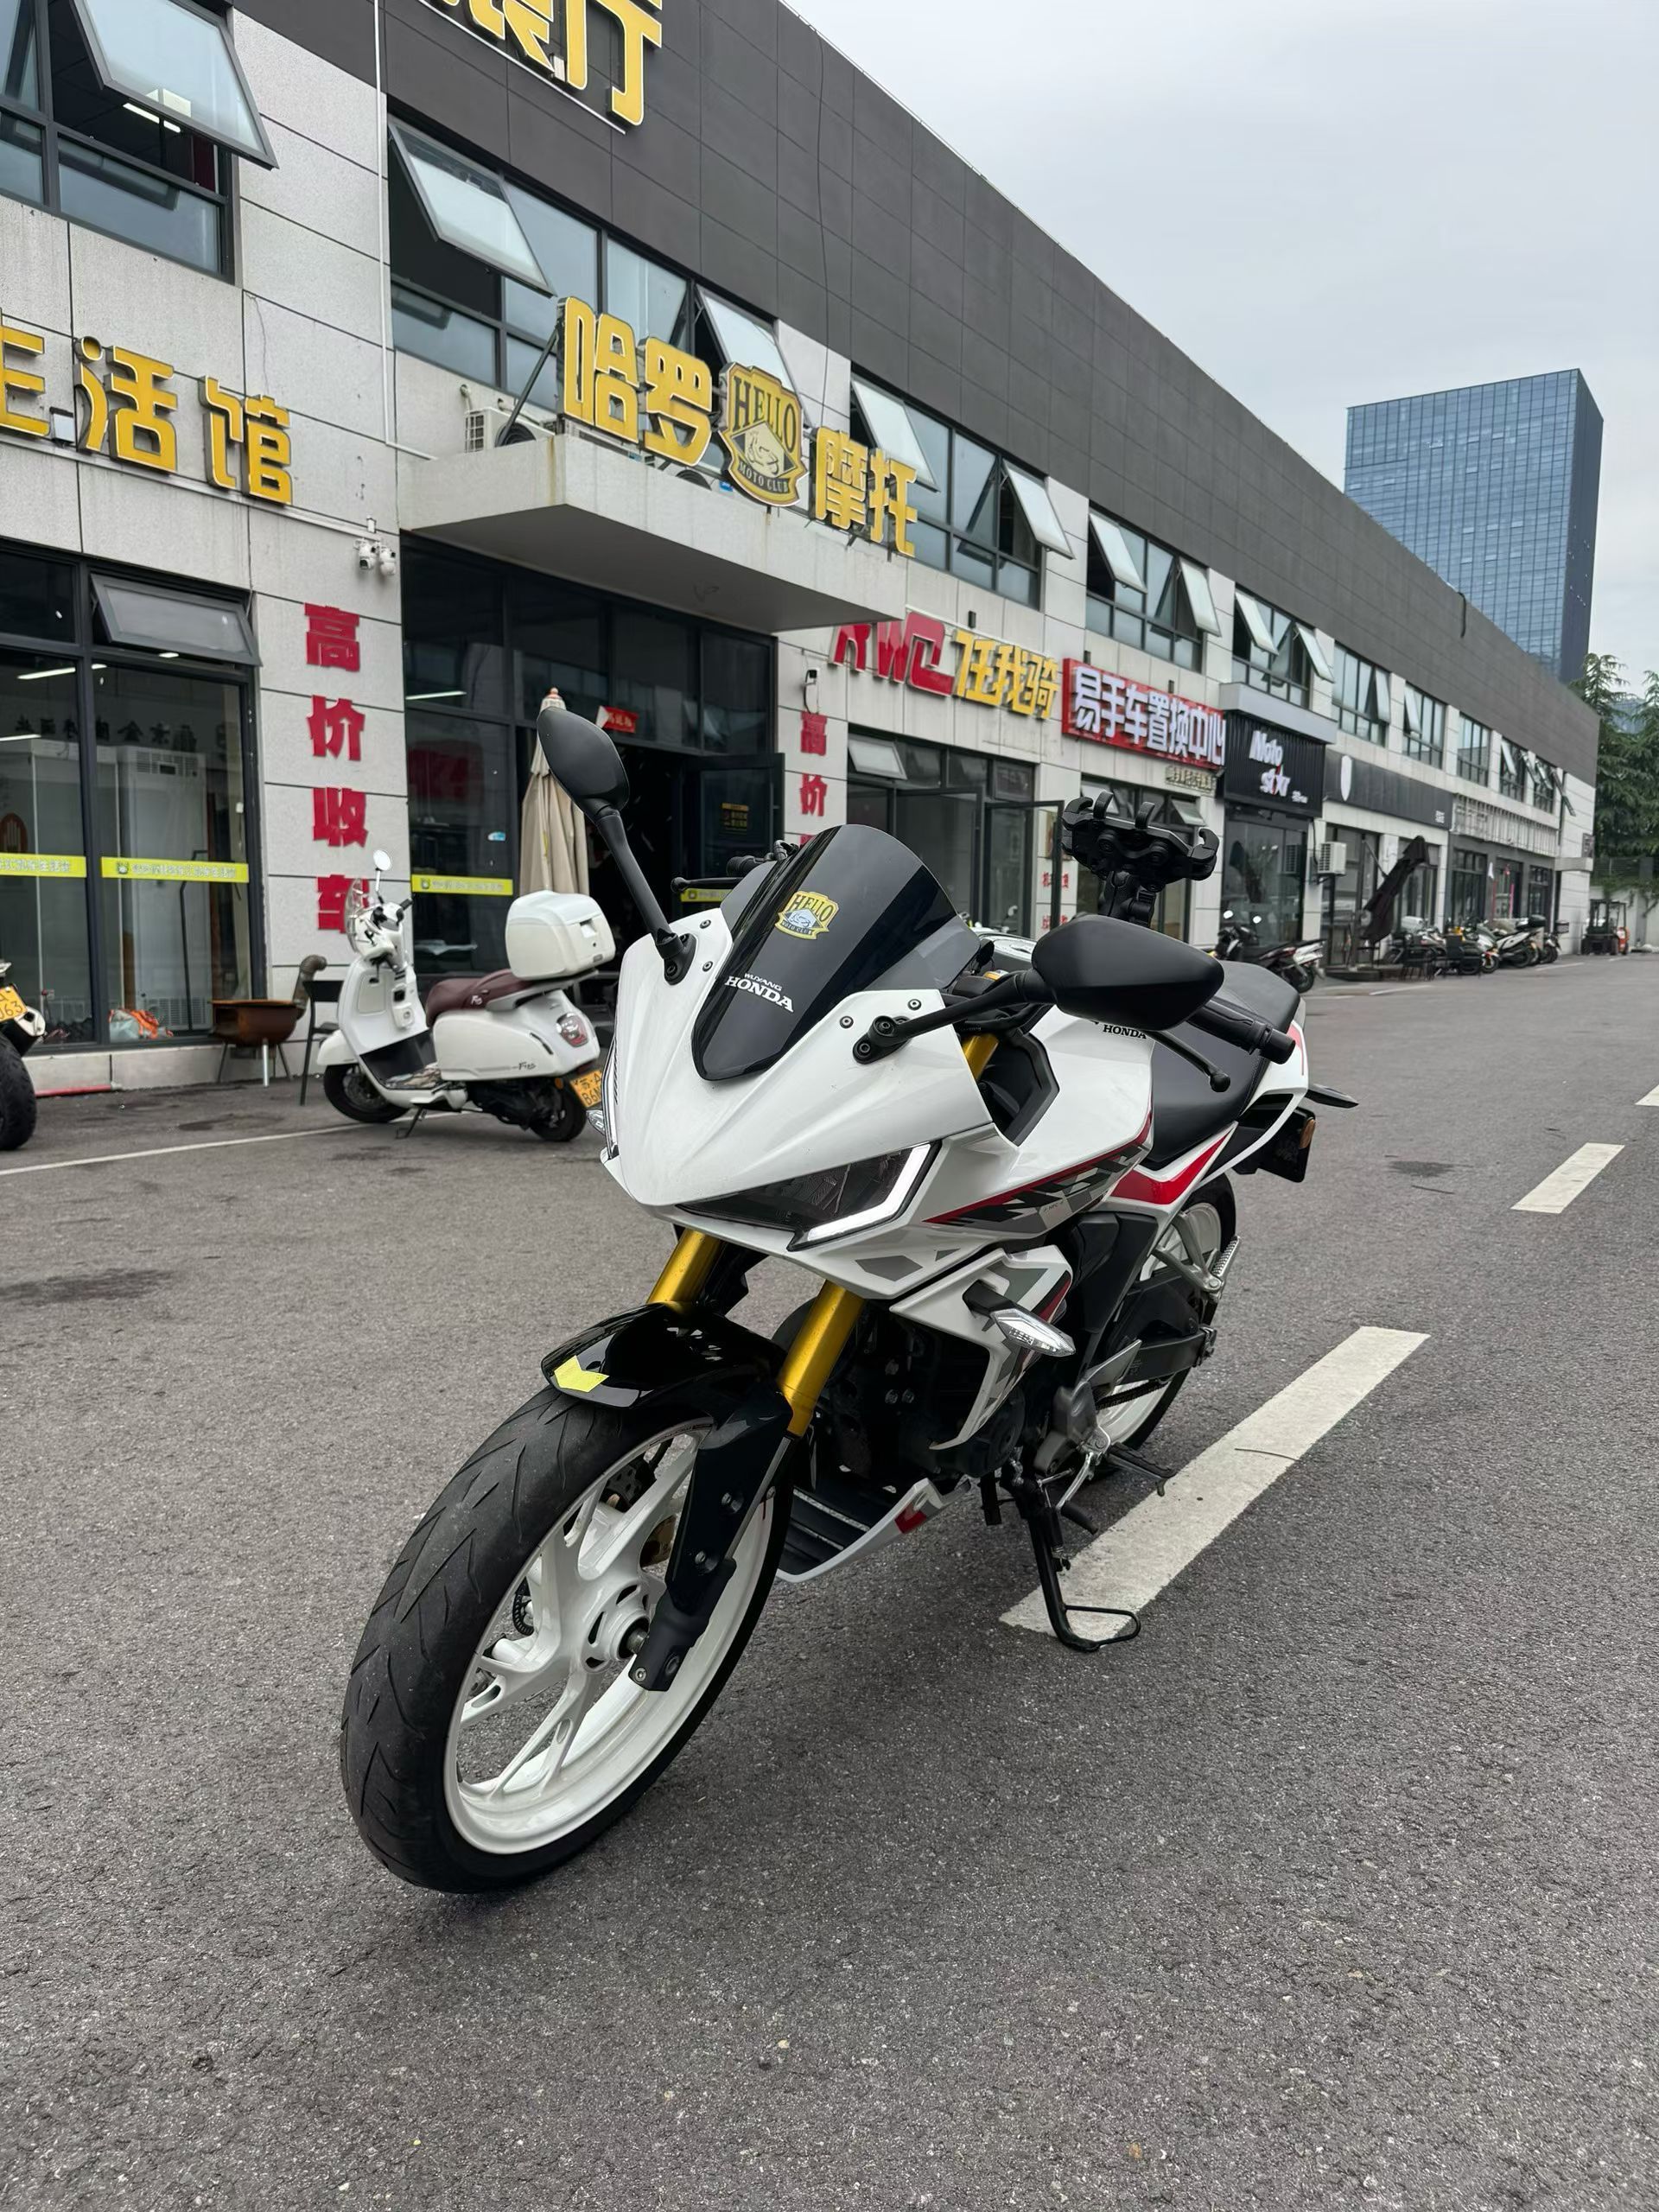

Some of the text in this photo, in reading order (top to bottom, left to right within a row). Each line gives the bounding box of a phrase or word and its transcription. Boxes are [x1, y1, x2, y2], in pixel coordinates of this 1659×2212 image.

[563, 296, 918, 558] 哈罗 摩托
[733, 374, 798, 454] HELLO
[737, 459, 790, 494] MOTO CLUB
[953, 628, 1059, 720] 任我骑
[304, 601, 370, 935] 高价收车
[788, 893, 835, 923] HELLO
[796, 925, 813, 935] CLUB
[724, 975, 794, 1013] HONDA
[743, 972, 783, 992] WUYANG
[1103, 1024, 1147, 1039] HONDA
